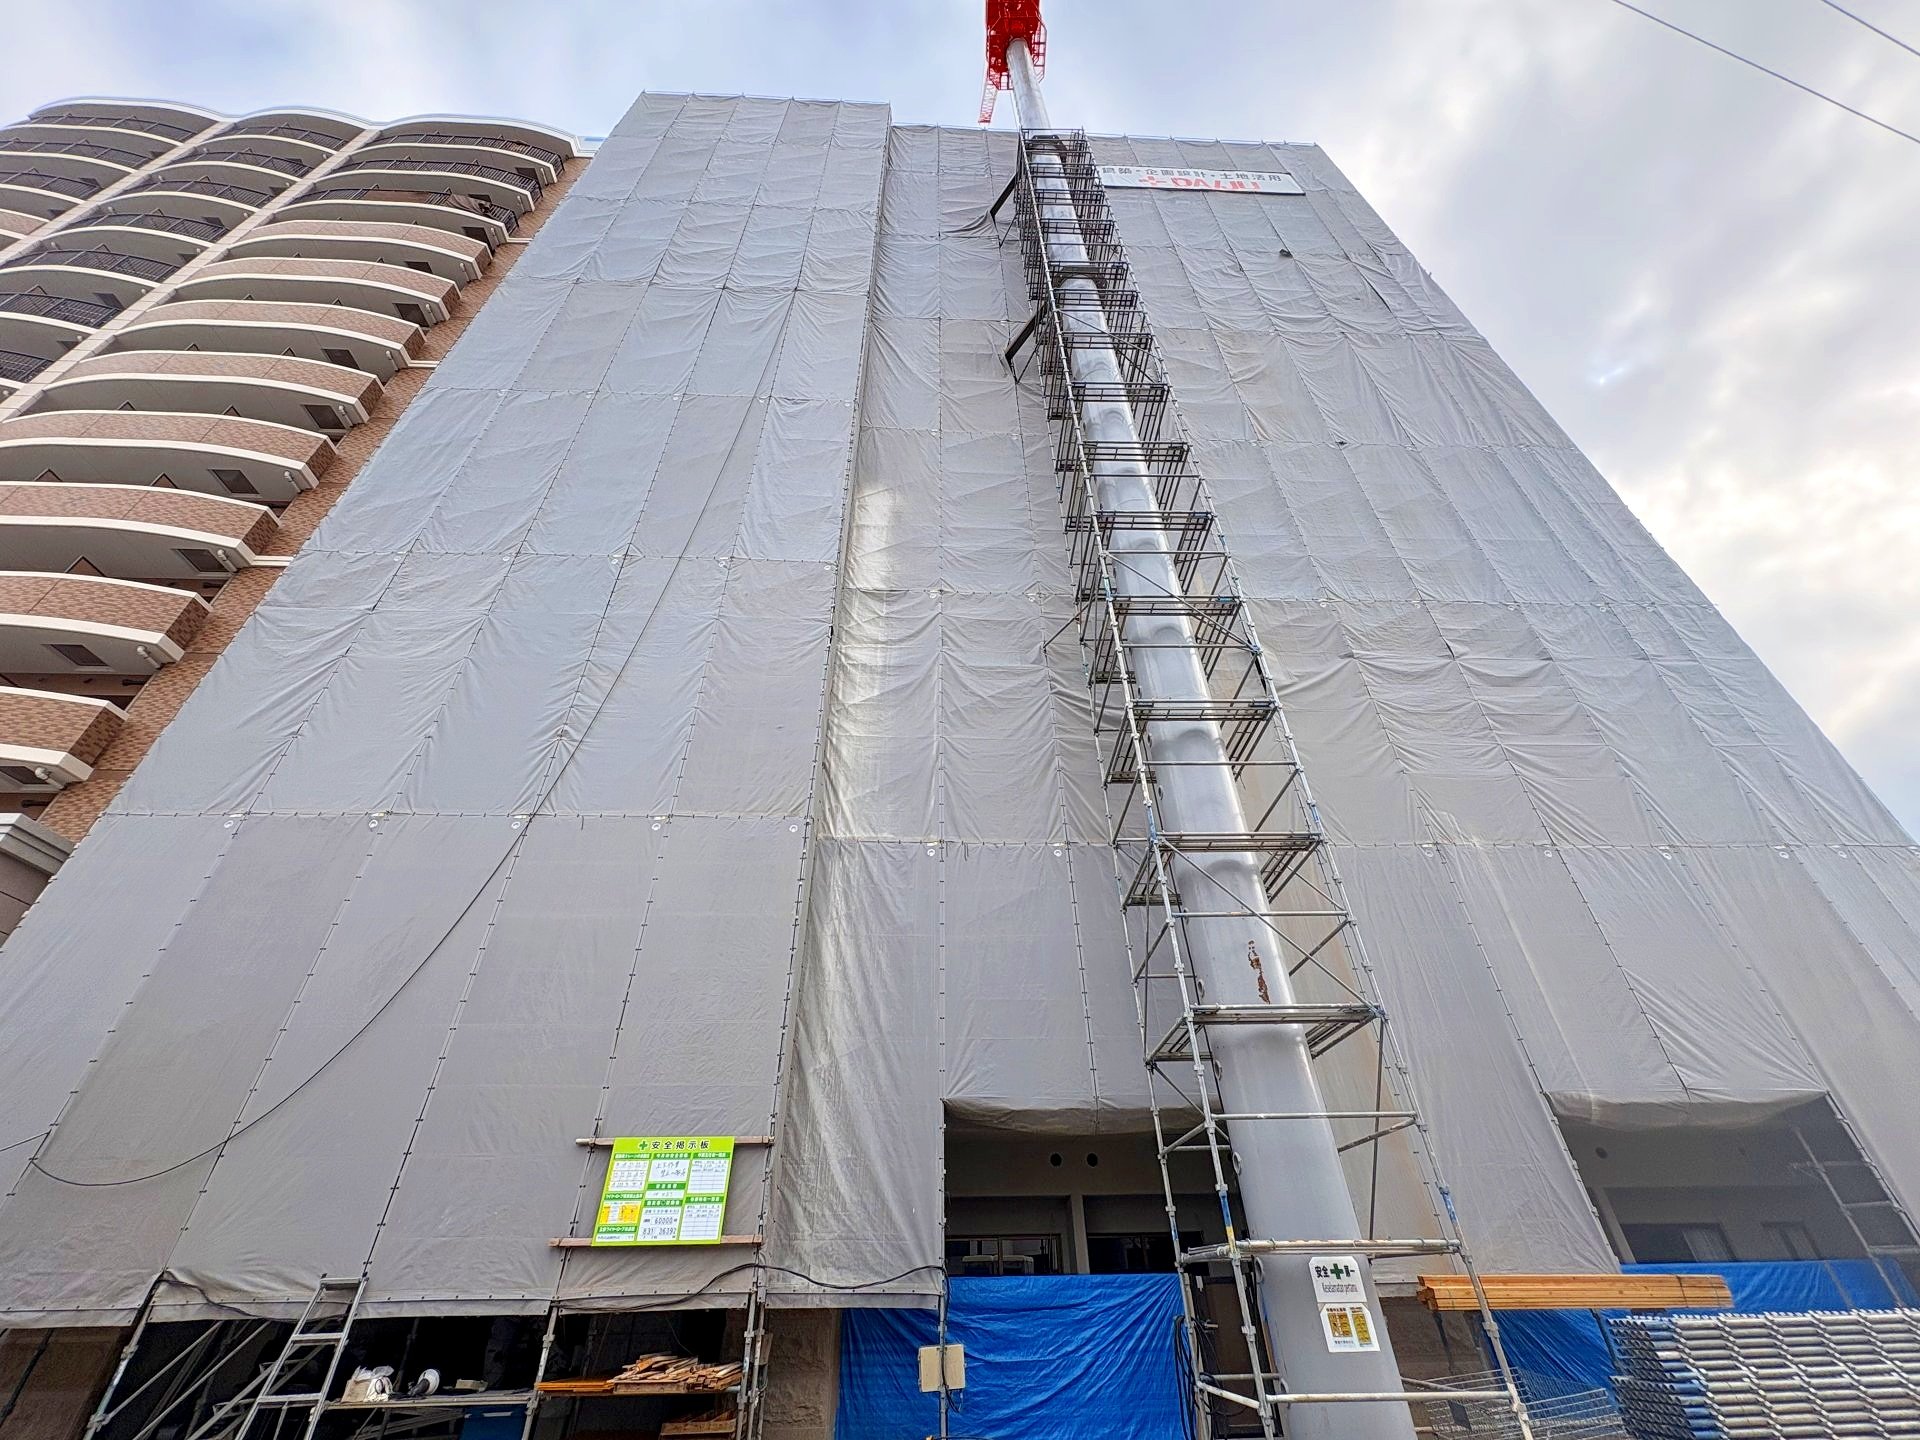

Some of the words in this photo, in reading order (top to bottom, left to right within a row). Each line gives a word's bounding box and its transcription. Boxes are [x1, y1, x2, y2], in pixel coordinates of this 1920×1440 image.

[651, 1140, 710, 1150] 安全掲示板
[1314, 1265, 1330, 1278] 安全
